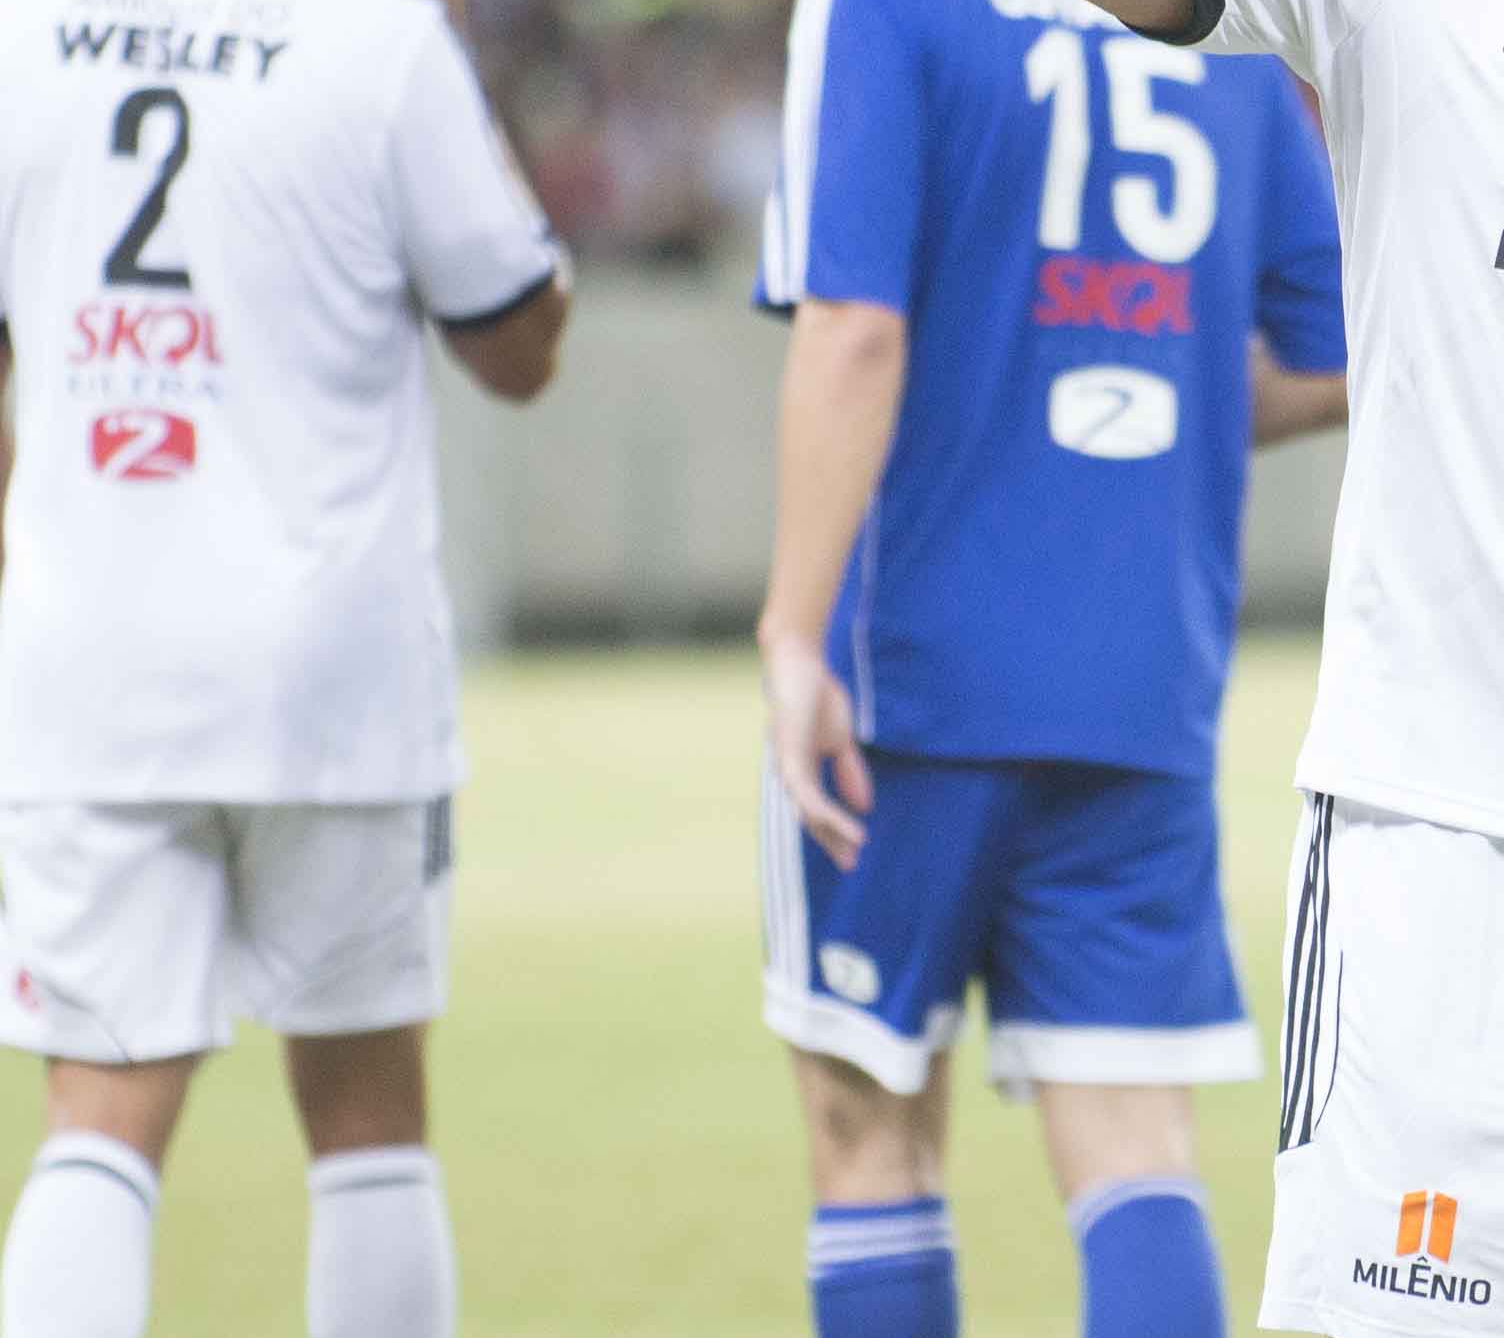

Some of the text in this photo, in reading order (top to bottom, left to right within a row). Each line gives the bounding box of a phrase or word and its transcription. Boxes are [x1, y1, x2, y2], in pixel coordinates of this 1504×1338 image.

[57, 23, 288, 82] WESLEY
[1024, 30, 1219, 263] 15
[104, 87, 192, 290] 2
[66, 301, 226, 367] SKOL
[1352, 1256, 1492, 1306] MILÊNIO
